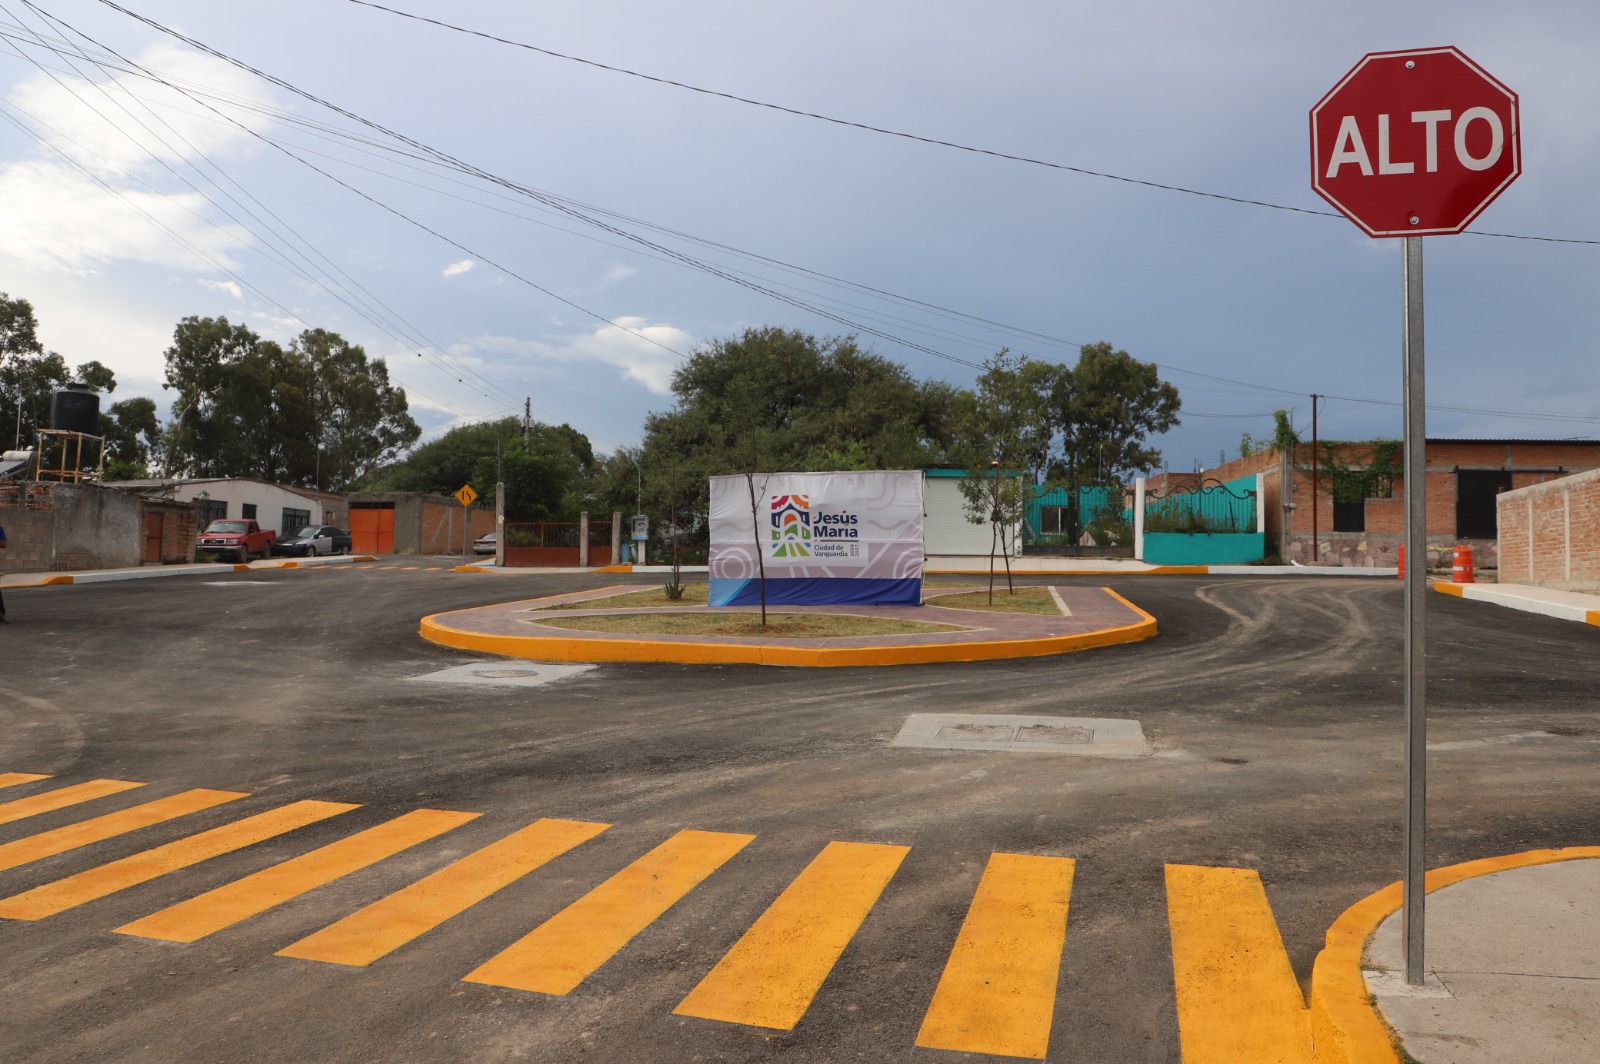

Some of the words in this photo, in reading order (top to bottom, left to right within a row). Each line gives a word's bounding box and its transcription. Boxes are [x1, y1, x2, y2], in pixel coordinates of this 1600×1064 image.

[1325, 106, 1504, 178] ALTO
[813, 510, 858, 525] Jesús
[813, 523, 858, 538] María
